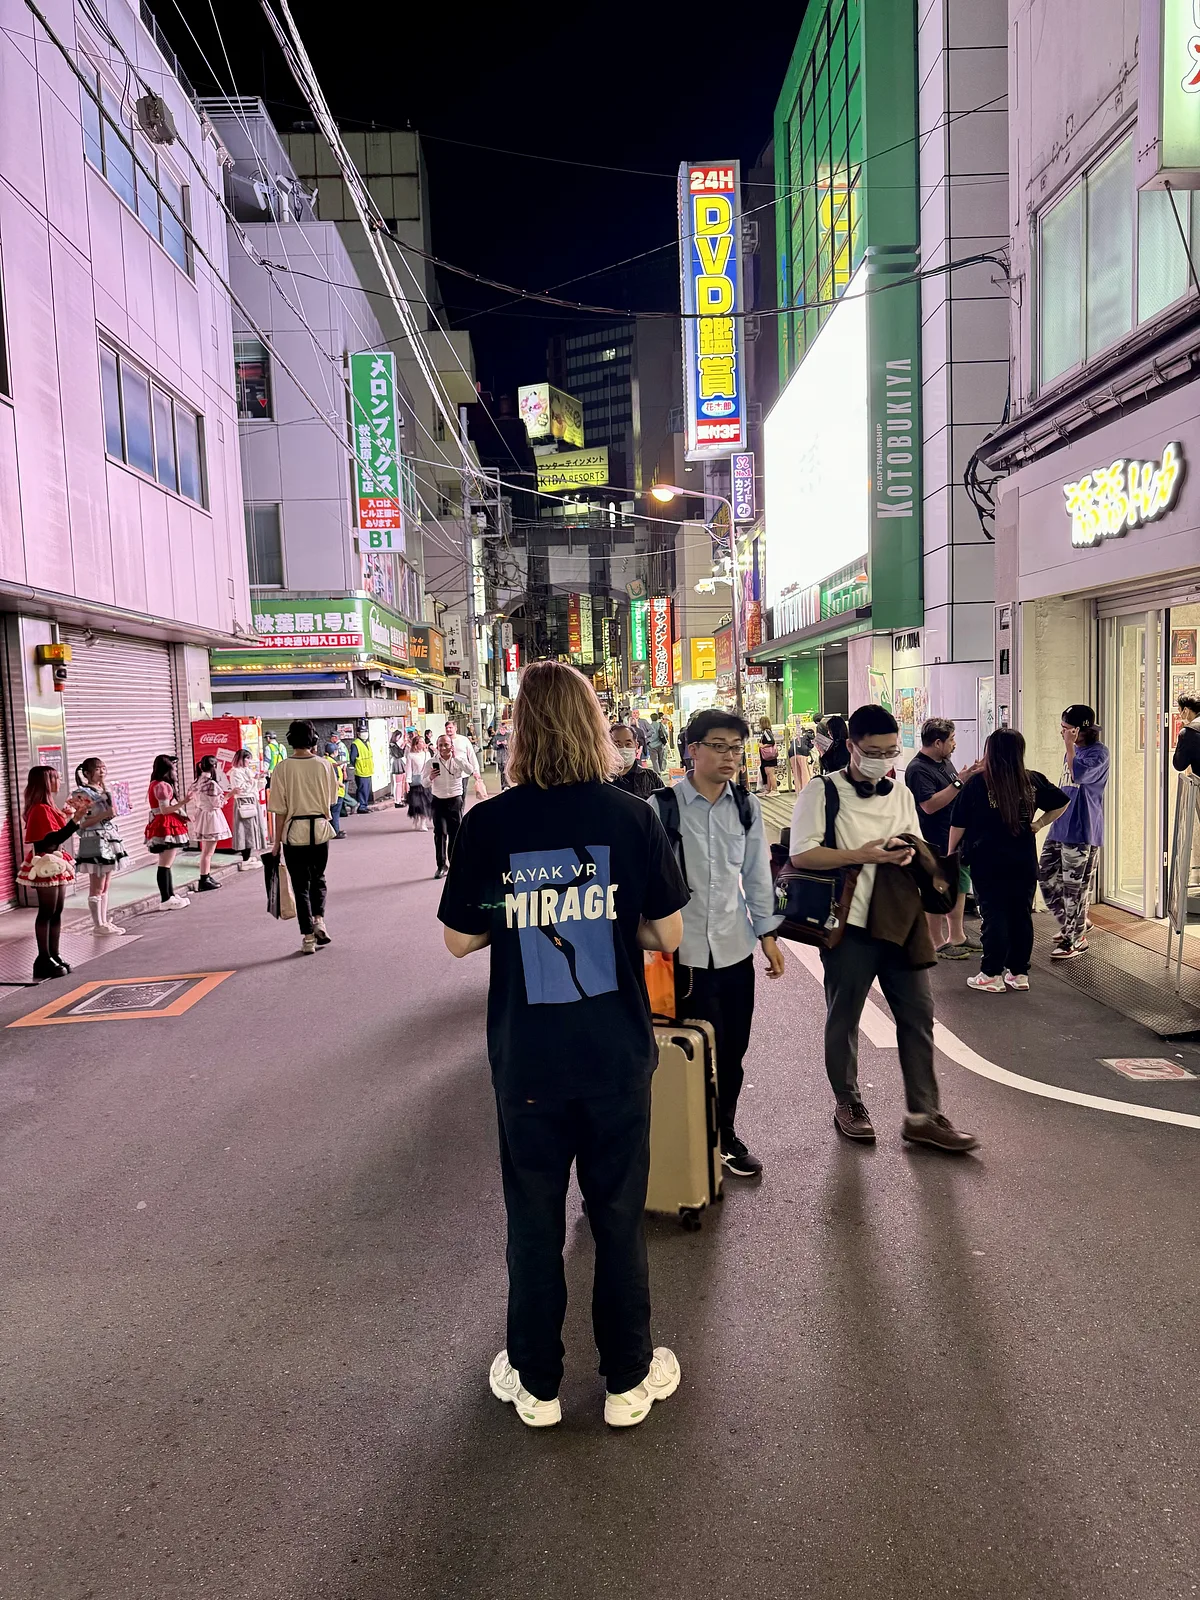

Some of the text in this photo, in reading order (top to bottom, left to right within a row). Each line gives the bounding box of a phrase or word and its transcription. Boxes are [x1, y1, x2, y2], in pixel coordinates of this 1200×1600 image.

[690, 170, 734, 191] 24H
[693, 194, 736, 399] DVD鑑賞
[370, 358, 394, 492] メロンブックス
[876, 358, 913, 518] KOTOBUKIYA
[538, 455, 605, 471] エンターテインメント
[538, 471, 605, 487] KIBA RESORTS
[744, 478, 752, 503] メイド
[739, 506, 749, 515] 2F
[369, 530, 393, 548] B1
[254, 611, 363, 633] 秋葉原1号店
[340, 636, 359, 645] B1F
[502, 863, 597, 885] KAYAK VR
[505, 884, 619, 929] MIRAGE
